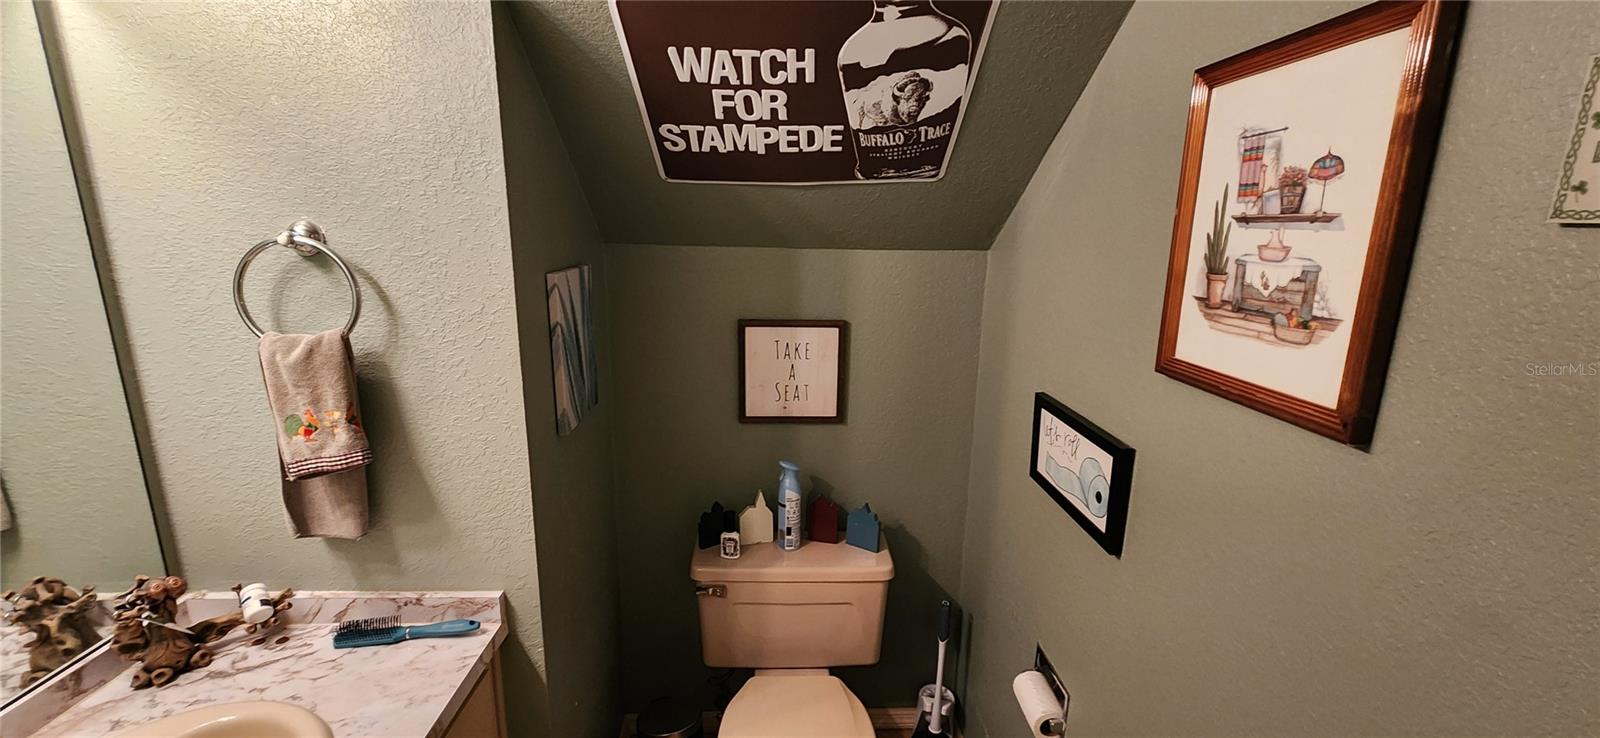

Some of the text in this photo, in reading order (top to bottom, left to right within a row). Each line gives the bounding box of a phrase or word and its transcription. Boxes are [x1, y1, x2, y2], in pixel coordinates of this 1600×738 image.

[667, 46, 815, 85] WATCH
[712, 89, 788, 121] FOR
[658, 124, 845, 154] STAMPEDE
[859, 122, 951, 147] BUFFALO TRACE
[774, 340, 811, 360] TAKE
[788, 363, 796, 380] A
[775, 382, 809, 402] SEAT
